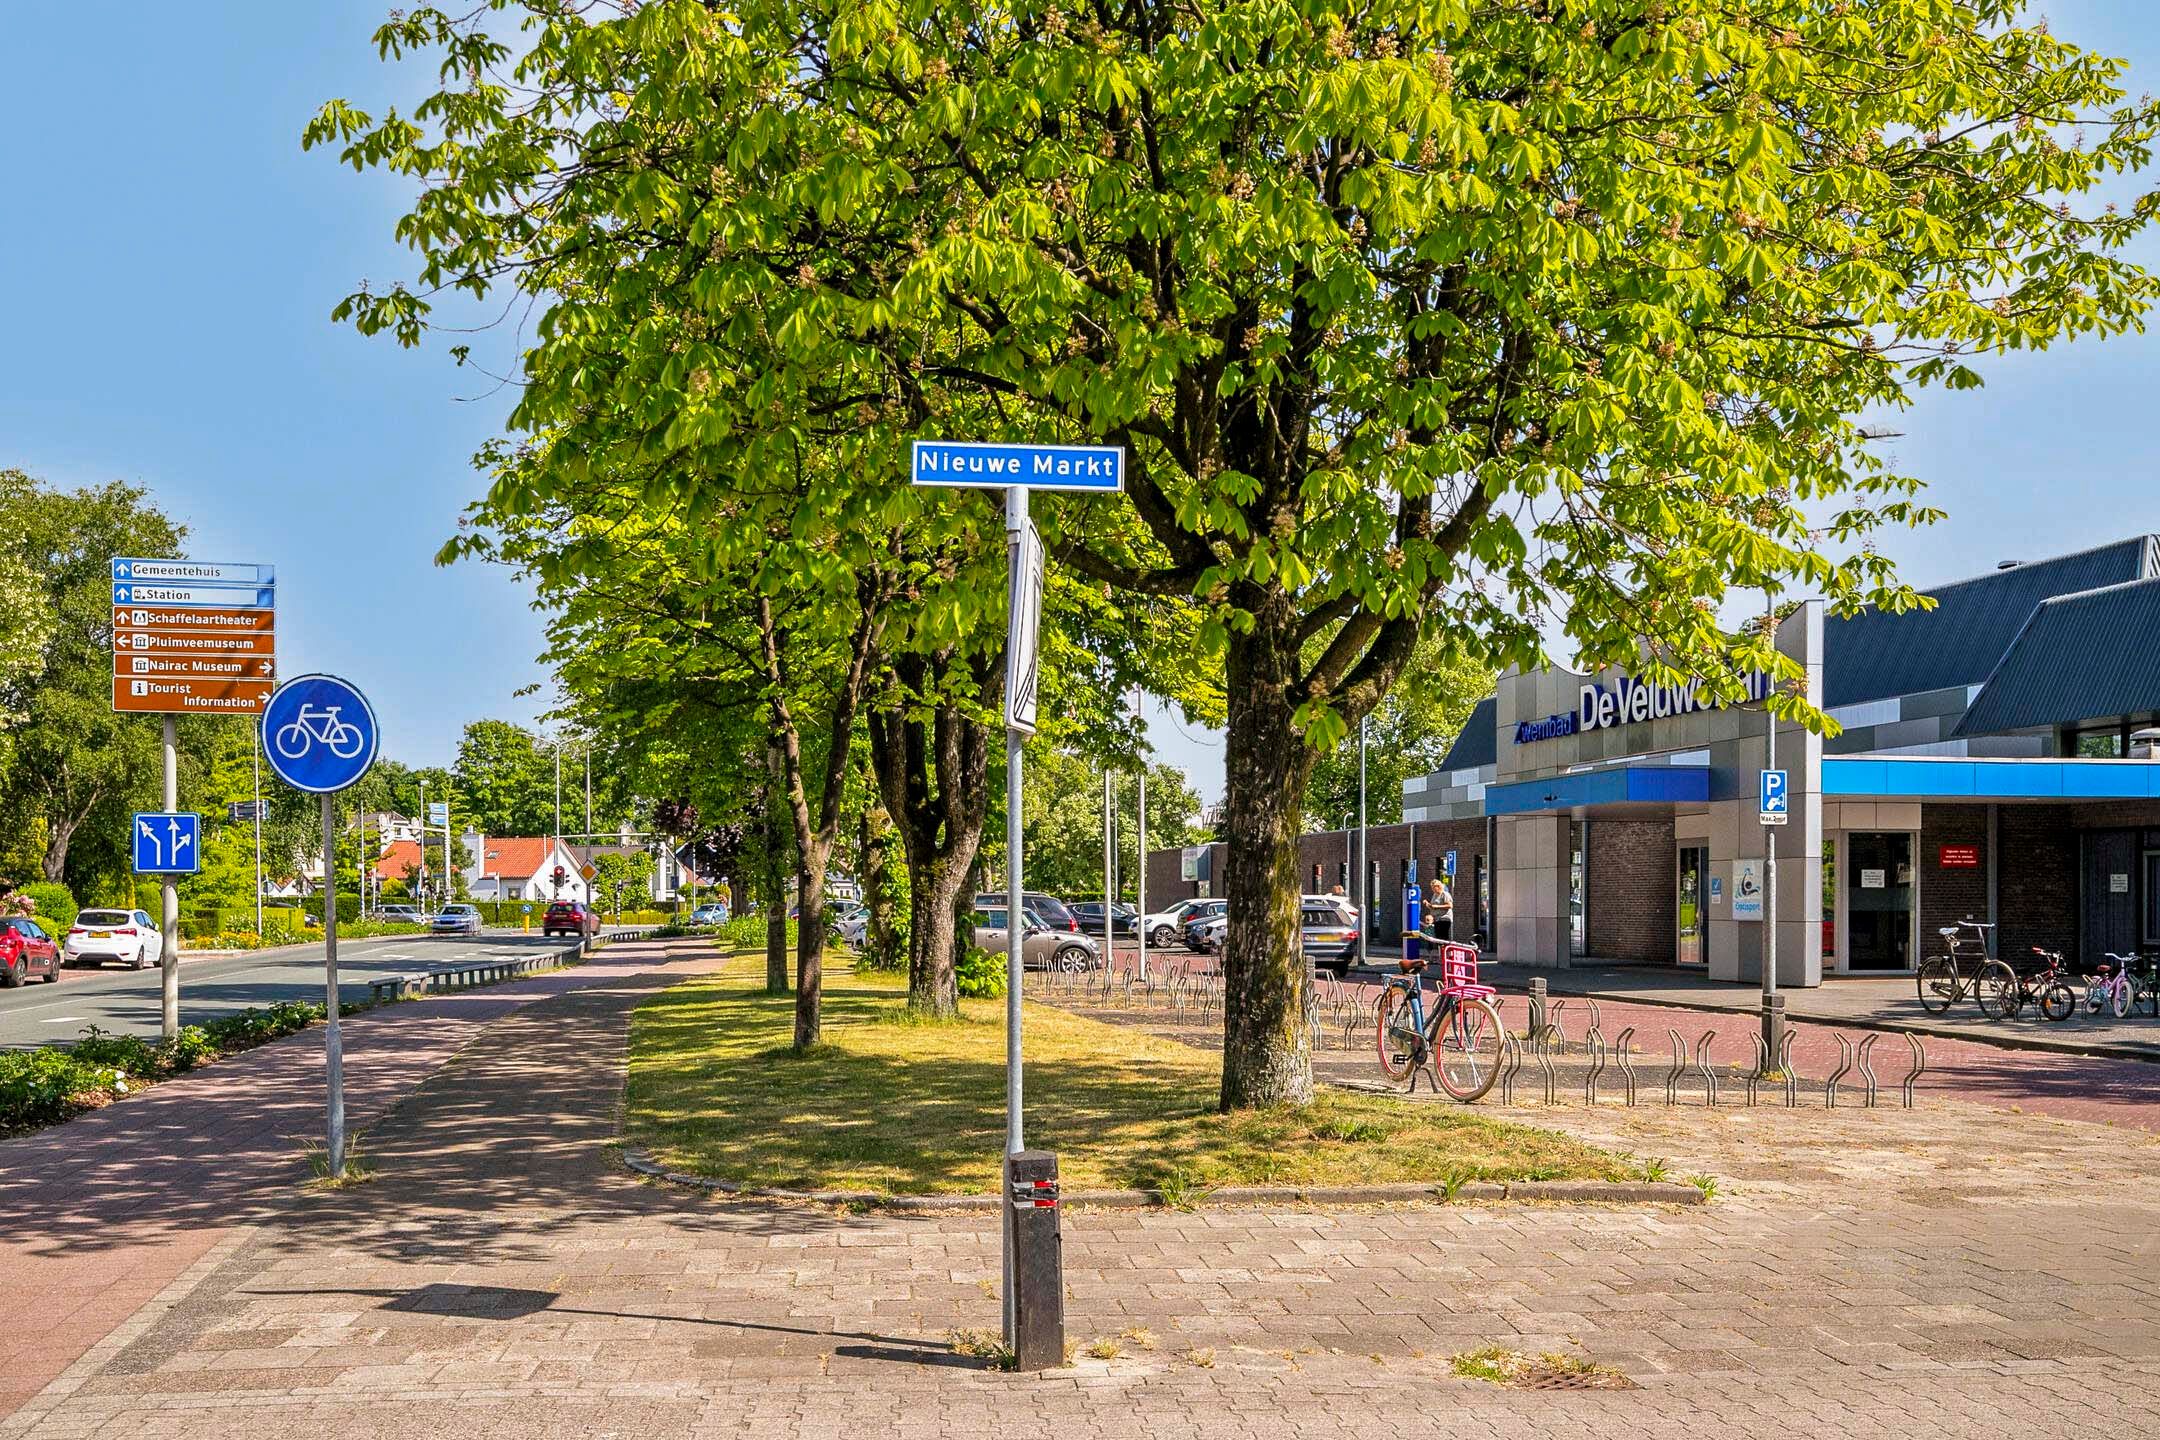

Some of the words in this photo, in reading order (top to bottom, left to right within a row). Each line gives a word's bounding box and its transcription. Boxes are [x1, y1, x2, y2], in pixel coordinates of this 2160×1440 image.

[920, 451, 1021, 473] Nieuwe
[1033, 454, 1113, 476] Markt
[133, 564, 221, 577] Gemeentehuis
[147, 590, 191, 600] Station
[148, 613, 257, 626] Schaffelaartheater
[149, 636, 254, 649] Pluimveemuseum
[150, 660, 188, 671] Nairac
[192, 661, 242, 672] Museum
[149, 683, 191, 694] Tourist
[184, 696, 256, 708] Information
[1766, 773, 1782, 796] P
[1408, 888, 1417, 900] P
